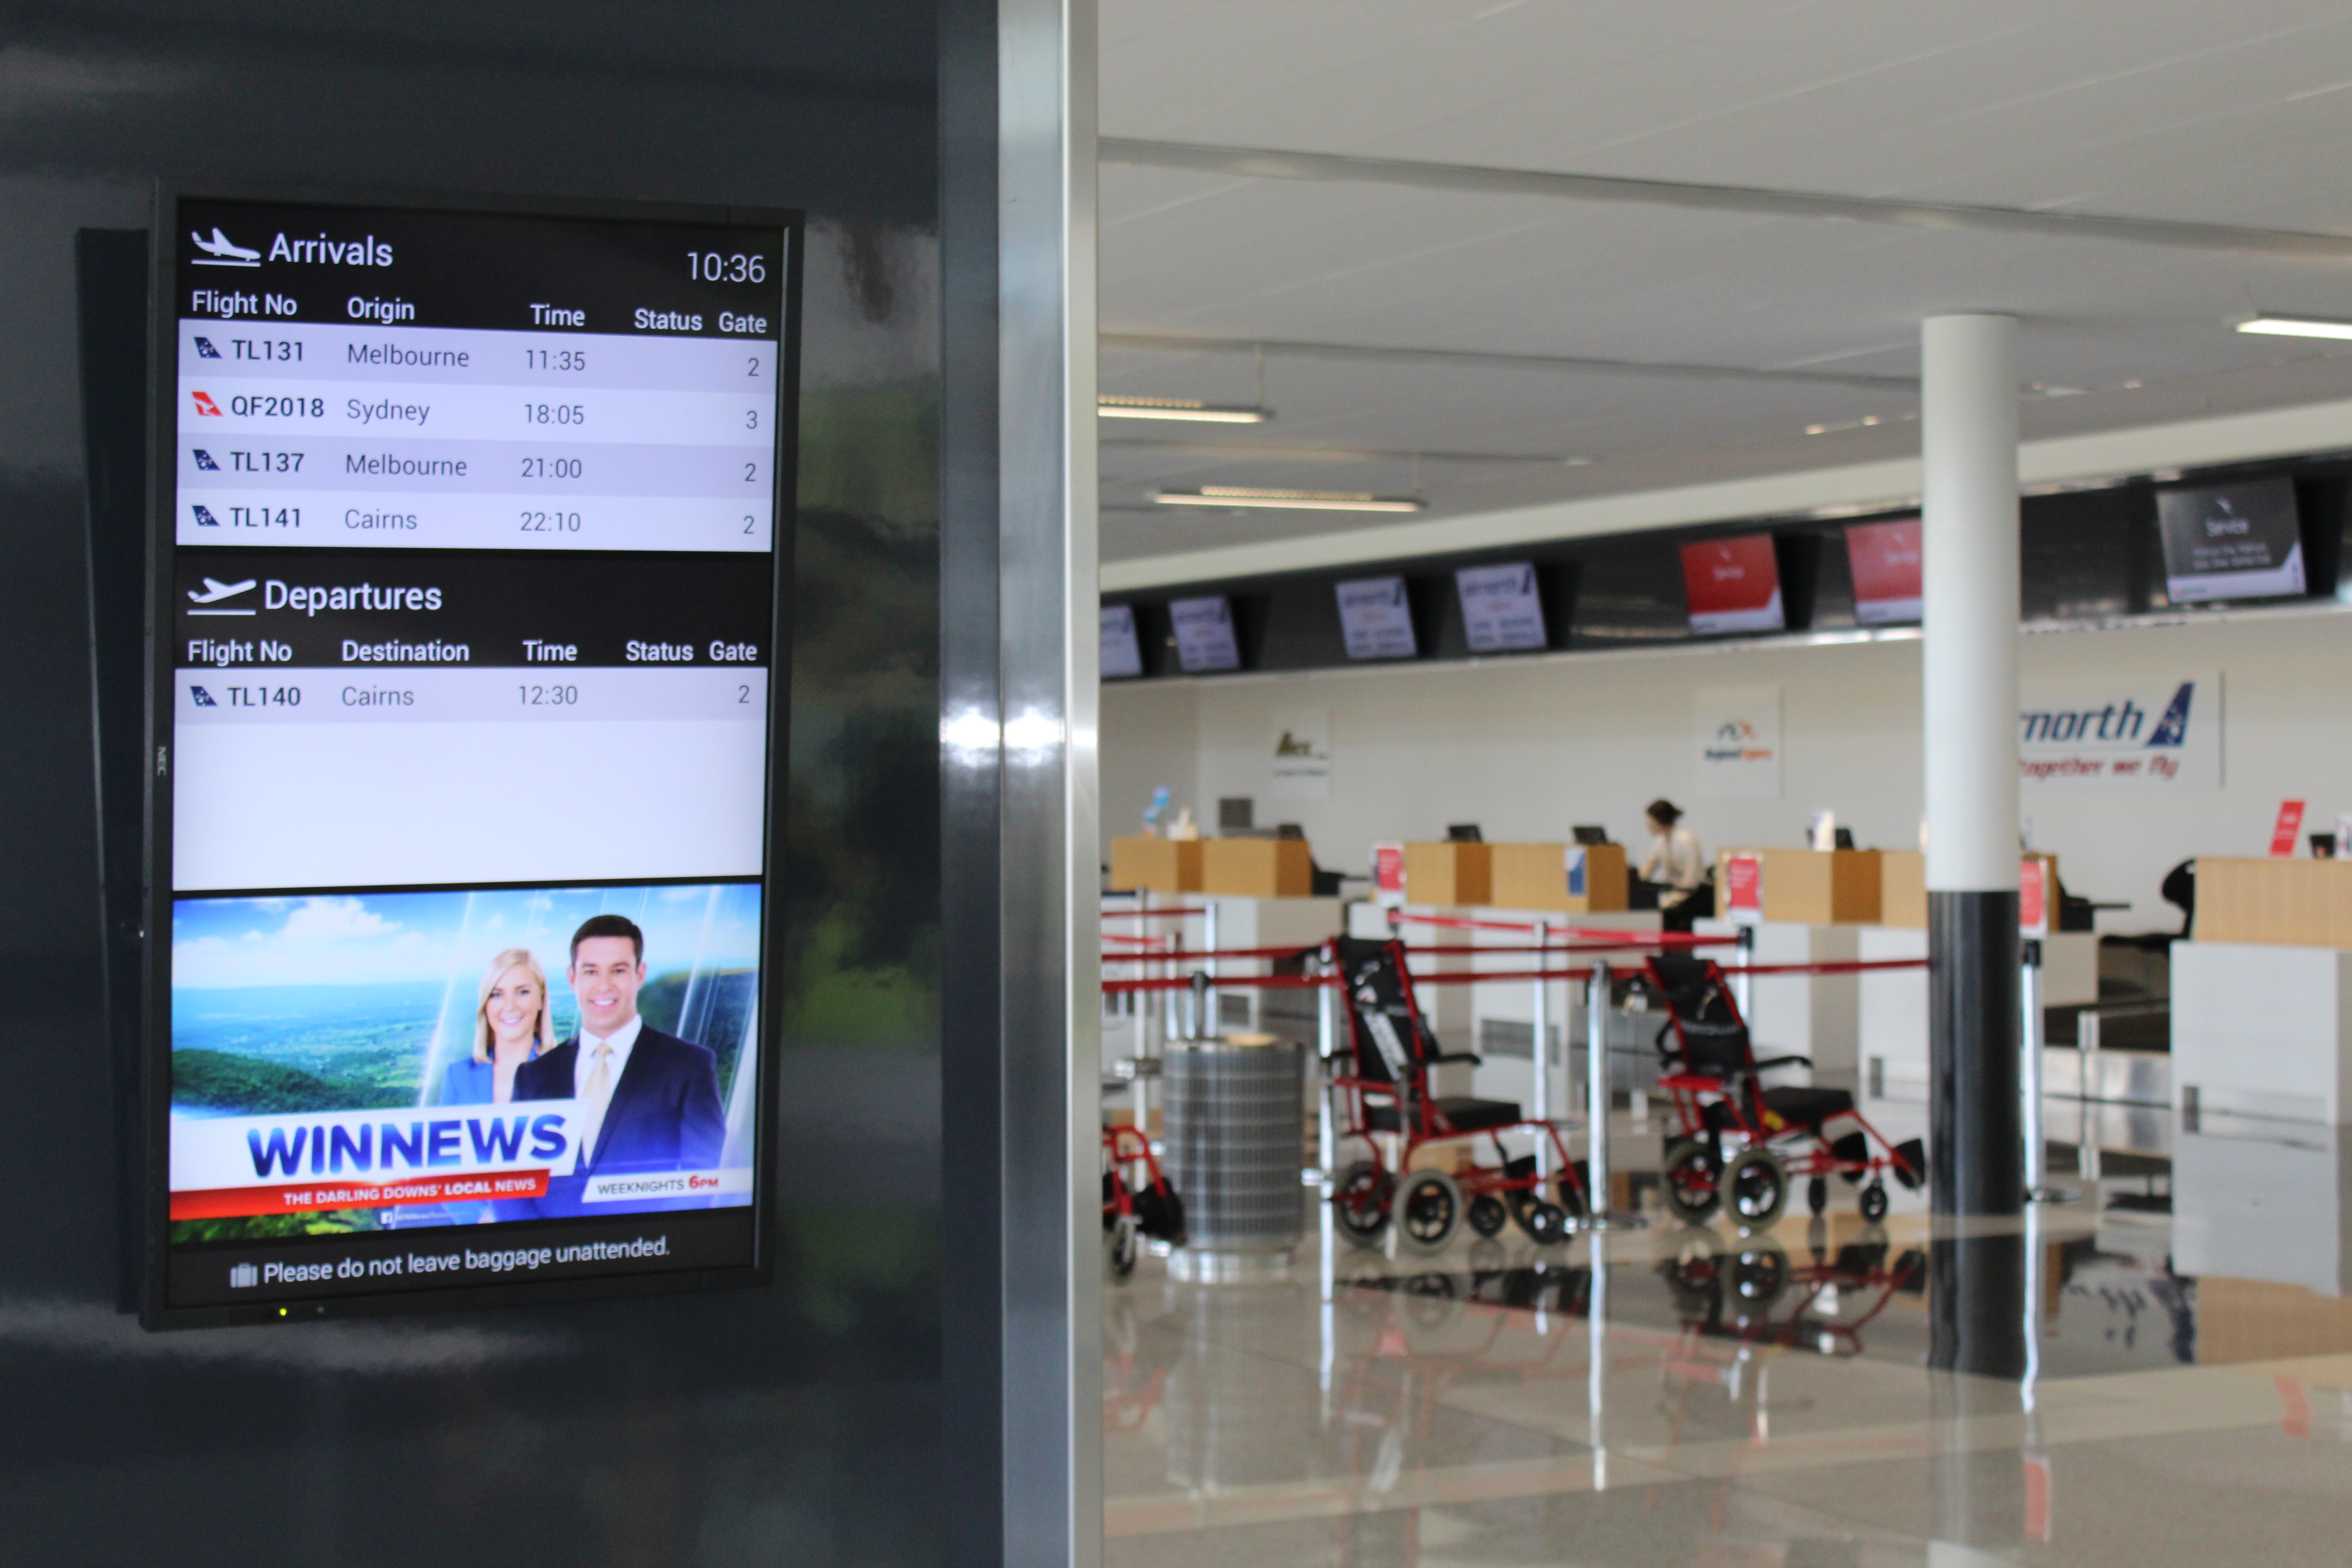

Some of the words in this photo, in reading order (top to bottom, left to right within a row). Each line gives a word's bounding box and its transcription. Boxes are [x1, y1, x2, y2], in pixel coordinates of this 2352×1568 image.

[269, 233, 392, 266] Arrivals
[688, 252, 765, 283] 10:36
[193, 291, 257, 318] Flight
[265, 294, 297, 315] No
[348, 297, 414, 324] Origin
[530, 304, 585, 326] Time
[635, 309, 702, 331] Status
[719, 312, 767, 333] Gate
[232, 340, 302, 361] TL131
[348, 344, 469, 367] Melbourne
[526, 350, 585, 371] 11:35
[748, 358, 759, 377] 2
[232, 396, 323, 417] QF2018
[348, 399, 430, 426] Sydney
[525, 404, 584, 425] 18:05
[746, 411, 757, 429] 3
[230, 452, 304, 472] TL137
[347, 454, 466, 476] Melbourne
[522, 458, 582, 478] 21:00
[745, 463, 756, 481] 2
[230, 508, 299, 527] TL141
[345, 509, 417, 529] Cairns
[521, 512, 580, 532] 22:10
[744, 515, 754, 534] 2
[265, 580, 441, 617] Departures
[188, 640, 254, 667] Flight
[260, 641, 292, 661] No
[343, 640, 469, 661] Destination
[523, 640, 577, 661] Time
[626, 641, 693, 661] Status
[710, 641, 757, 661] Gate
[228, 687, 300, 706] TL140
[342, 686, 414, 706] Cairns
[519, 686, 578, 705] 12:30
[739, 685, 750, 703] 2
[157, 746, 166, 775] NEC
[284, 1192, 312, 1205] THE
[316, 1188, 380, 1203] DARLING
[383, 1185, 441, 1199] DOWNS'
[445, 1182, 491, 1195] LOCAL
[495, 1179, 536, 1192] NEWS
[598, 1180, 684, 1194] WEEKNIGHTS
[689, 1176, 719, 1188] 6PM
[264, 1262, 333, 1283] Please
[337, 1258, 364, 1278] do
[369, 1256, 402, 1275] not
[408, 1254, 461, 1273] leave
[466, 1248, 552, 1272] baggage
[556, 1236, 669, 1262] unattended.
